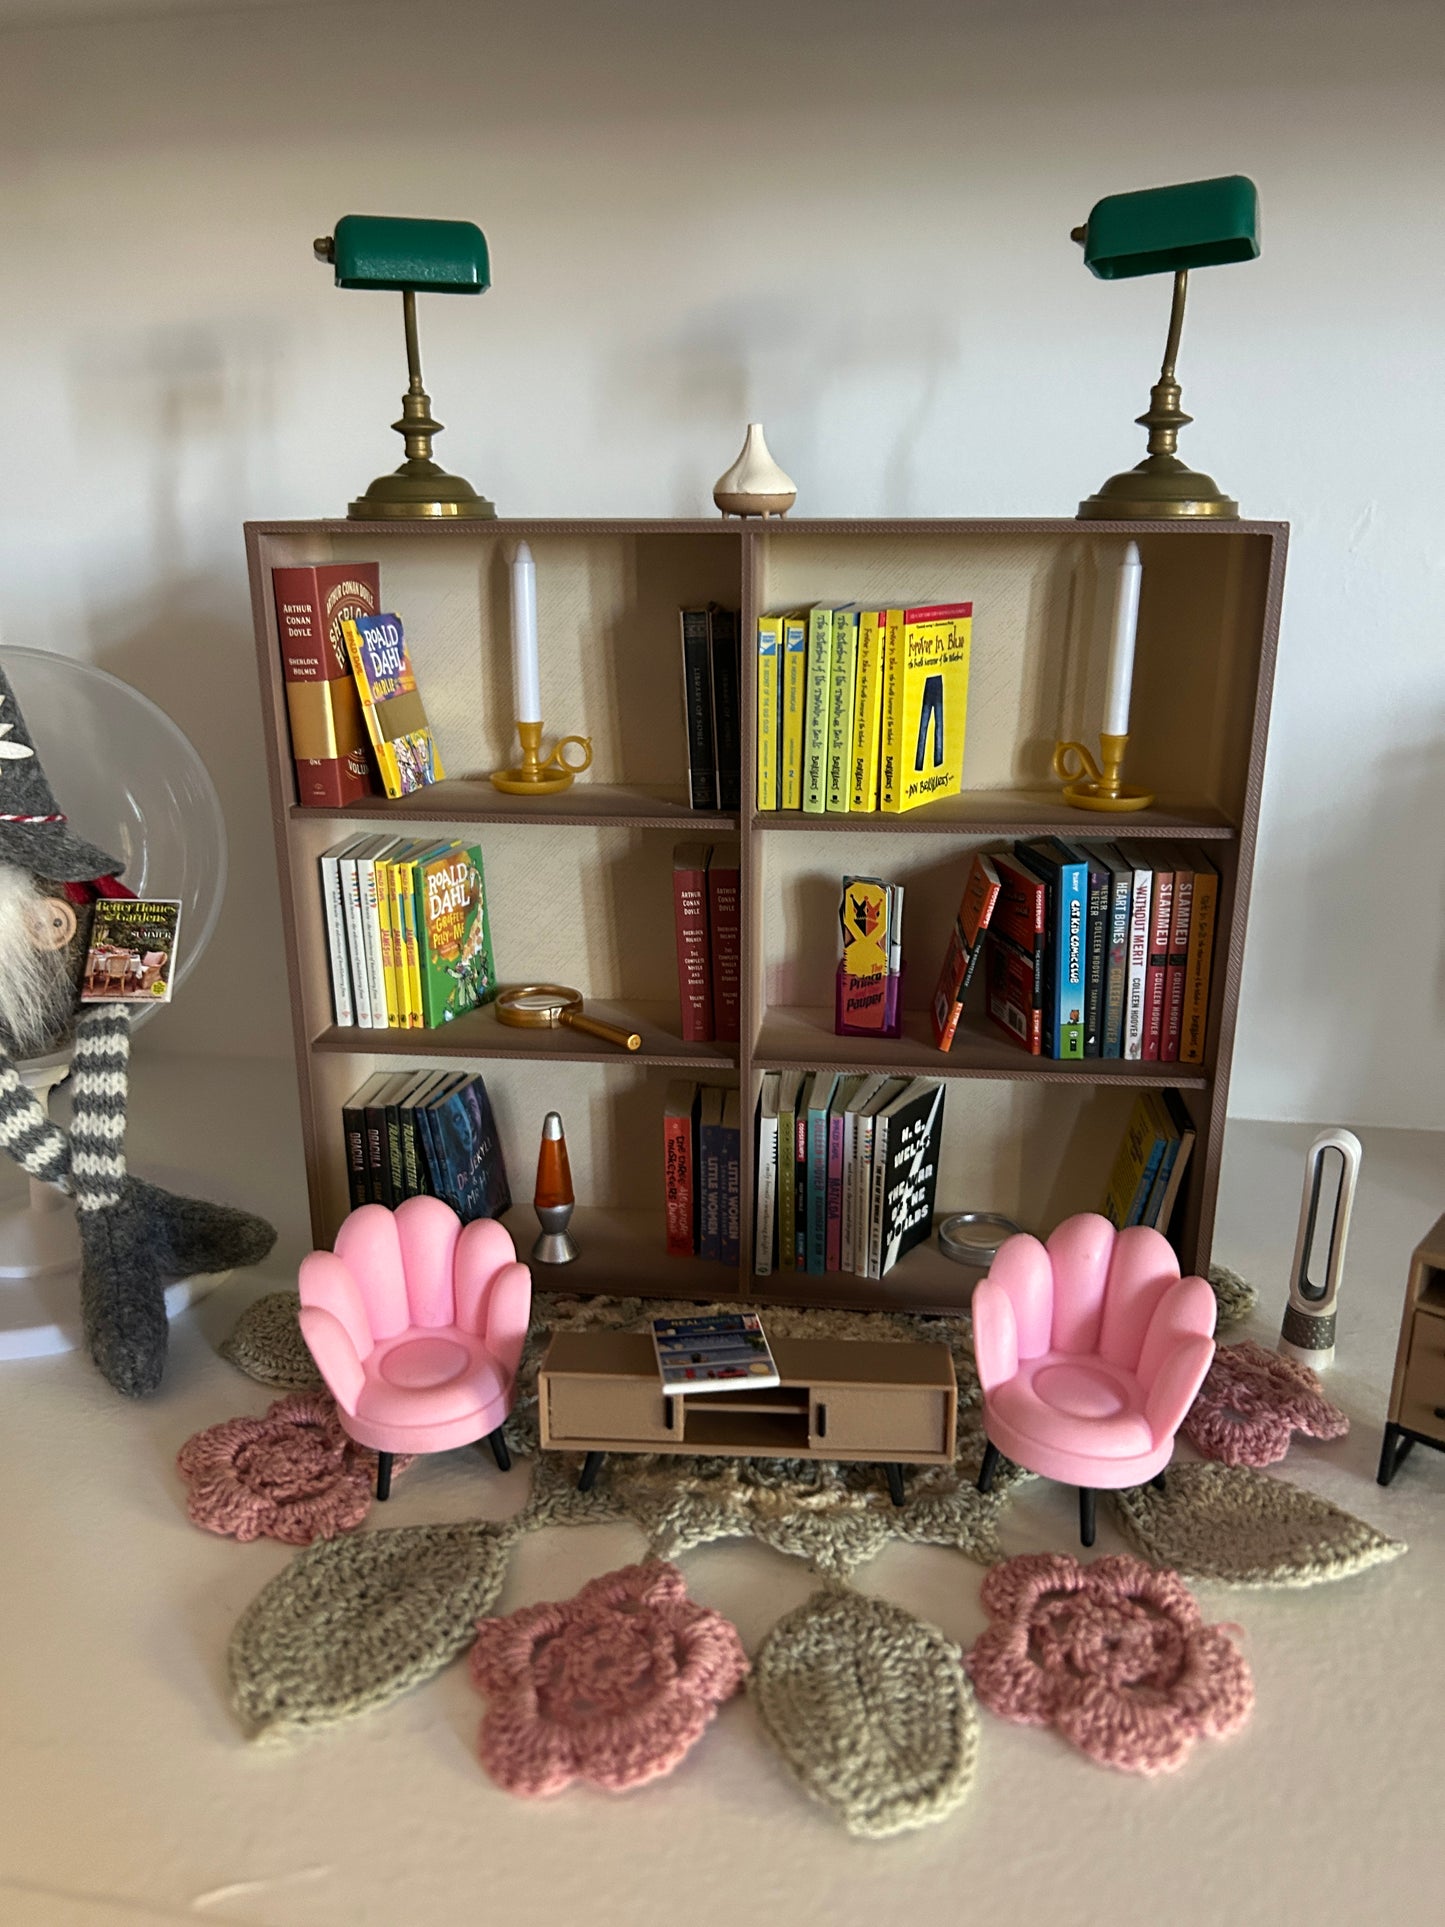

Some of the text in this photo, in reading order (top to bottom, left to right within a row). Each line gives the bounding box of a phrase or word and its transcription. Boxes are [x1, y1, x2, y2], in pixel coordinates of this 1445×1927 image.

[342, 580, 359, 596] CONAN
[284, 604, 312, 614] ARTHUR
[286, 616, 310, 625] CONAN
[288, 628, 312, 637] DOYLE
[364, 624, 398, 652] ROALD
[909, 625, 964, 656] Forever Blue
[370, 648, 406, 677] DAHL
[813, 666, 826, 674] of
[834, 666, 846, 674] of
[694, 667, 702, 702] LIBRARY
[428, 863, 468, 896] ROALD
[96, 902, 177, 914] Better Homes
[430, 884, 470, 920] DAHL
[719, 904, 735, 912] DOYLE
[983, 887, 1000, 926] GOOSEBUMPS
[1071, 900, 1080, 917] CAT
[1090, 890, 1099, 916] NEVER
[1100, 885, 1108, 910] NEVER
[116, 912, 166, 922] Gardens
[1113, 882, 1128, 944] HEART BONES
[1132, 886, 1147, 967] WITHOUT MERIT
[1155, 884, 1173, 946] SLAMMED
[1174, 883, 1192, 945] SLAMMED
[131, 930, 172, 939] SUMMER
[382, 928, 390, 951] JAMES
[406, 928, 414, 951] JAMES
[1091, 921, 1102, 983] COLLEEN HOOVER
[850, 972, 882, 991] Prince
[1070, 962, 1080, 984] CLUB
[847, 992, 884, 1012] Pauper
[1090, 989, 1098, 1010] TARRYN
[1107, 968, 1122, 1043] COLLEEN HOOVER
[1130, 978, 1140, 1038] COLLEEN HOOVER
[1150, 972, 1162, 1036] COLLEEN HOOVER
[1169, 972, 1181, 1036] COLLEEN HOOVER
[350, 1132, 364, 1171] DRACULA
[367, 1129, 381, 1168] DRACULA
[388, 1122, 402, 1188] FRANKENSTEIN
[402, 1123, 417, 1189] FRANKENSTEIN
[813, 1118, 824, 1191] COLLEEN HOOVER
[708, 1156, 718, 1235] LITTLE WOMEN
[728, 1160, 739, 1239] LITTLE WOMEN
[828, 1177, 840, 1219] MATILDA
[888, 1180, 905, 1205] THE
